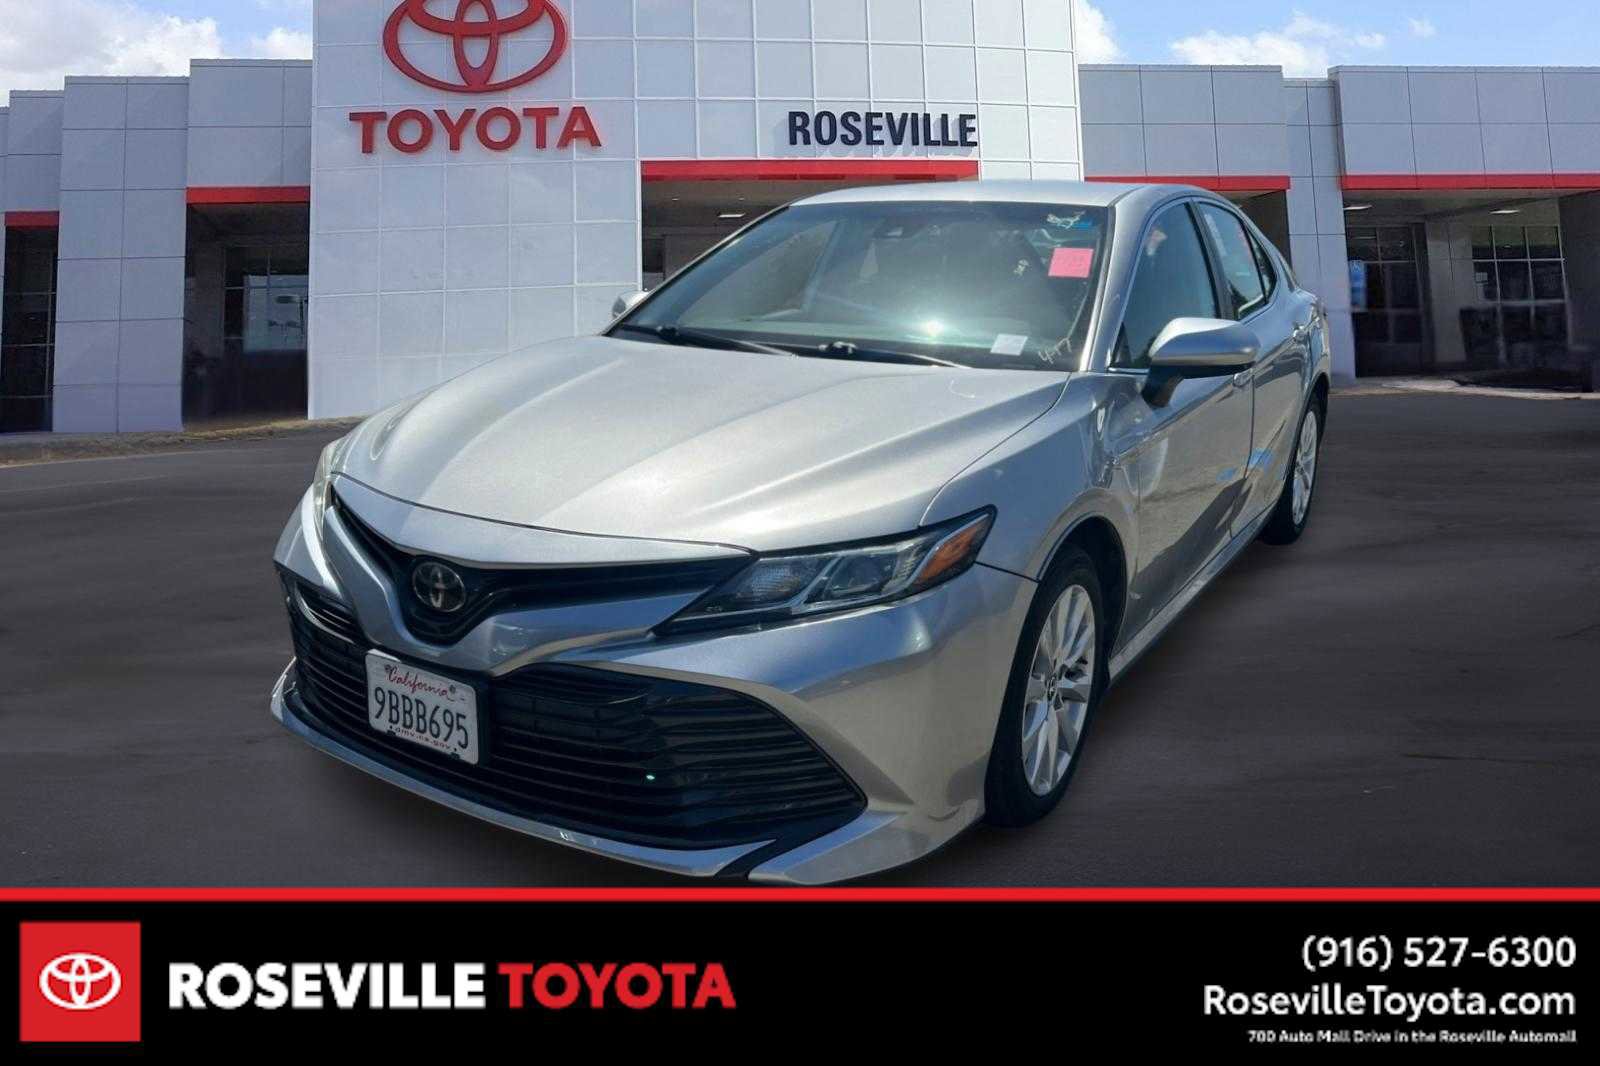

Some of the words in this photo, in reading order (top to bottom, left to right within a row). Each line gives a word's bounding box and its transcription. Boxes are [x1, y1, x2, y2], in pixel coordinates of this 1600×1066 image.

[349, 106, 603, 154] TOYOTA
[788, 111, 979, 147] ROSEVILLE
[387, 664, 450, 697] California
[374, 686, 469, 749] 9BBB695
